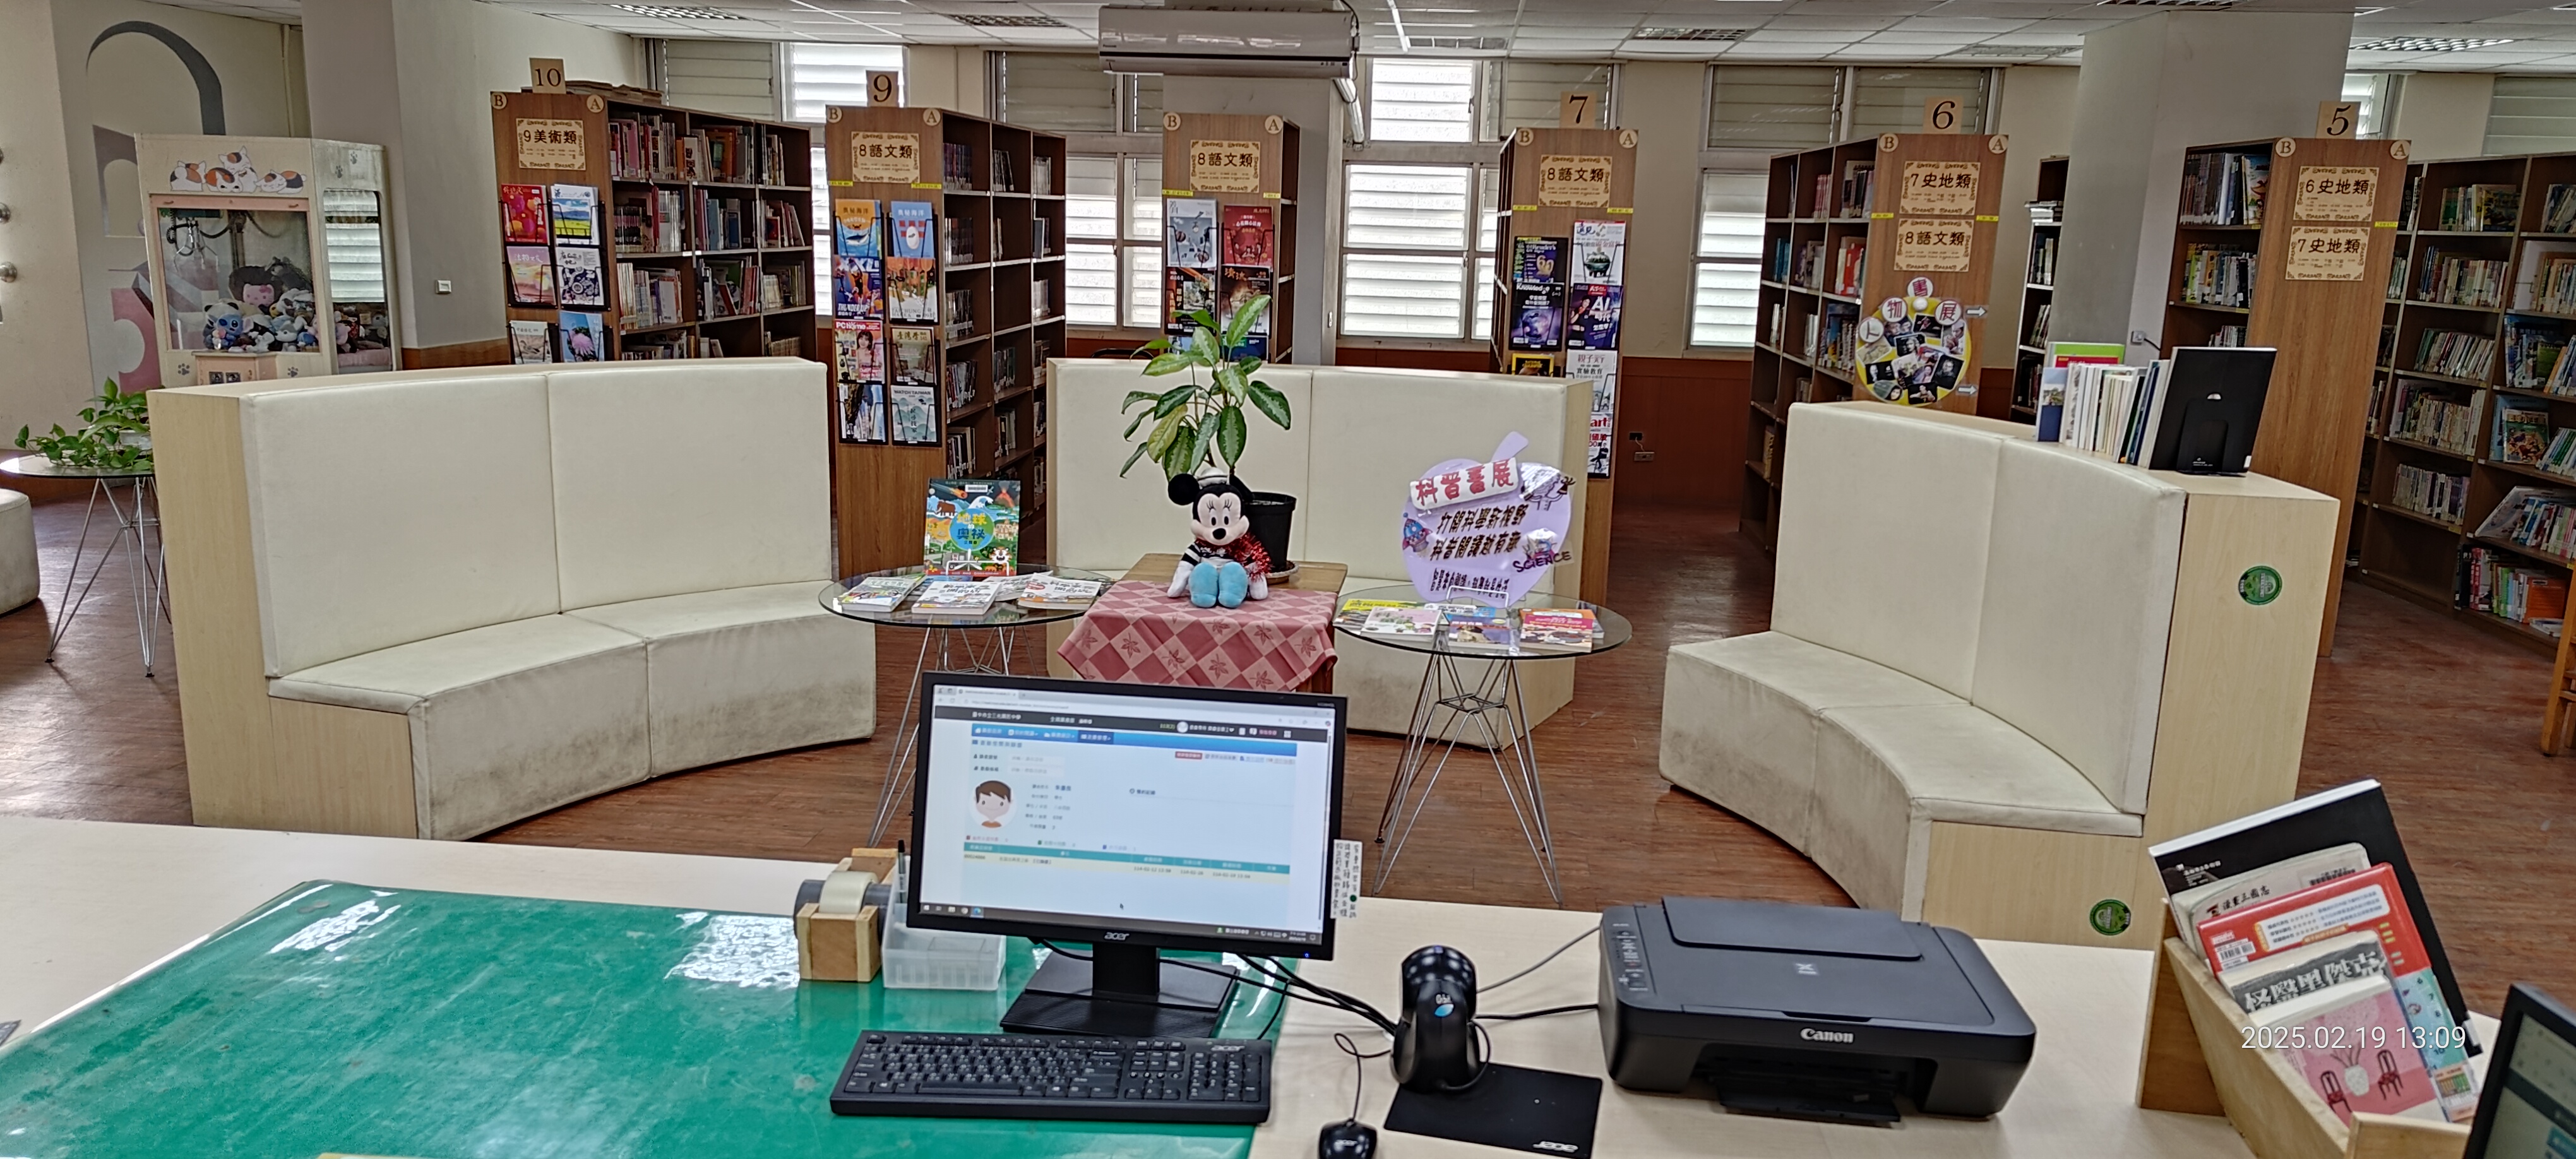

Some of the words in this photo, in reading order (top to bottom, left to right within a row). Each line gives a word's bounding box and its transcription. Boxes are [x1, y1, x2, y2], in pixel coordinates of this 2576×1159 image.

[535, 68, 561, 86] 10
[873, 74, 892, 102] 9
[494, 95, 503, 106] B
[590, 98, 601, 110] A
[829, 108, 838, 120] B
[1569, 95, 1589, 124] 7
[1932, 101, 1955, 129] 6
[926, 111, 938, 123] A
[1167, 116, 1177, 128] B
[2327, 104, 2351, 136] 5
[1268, 119, 1279, 131] A
[1520, 131, 1530, 143] B
[1622, 133, 1634, 145] A
[1883, 136, 1894, 148] B
[859, 144, 912, 158] 8語文類
[1992, 138, 2004, 151] A
[2280, 141, 2292, 154] B
[2393, 144, 2407, 157] A
[1198, 153, 1253, 167] 8語文類
[1547, 167, 1604, 183] 8語文類
[2306, 178, 2369, 195] 6史地類
[1905, 231, 1965, 246] 8語文類
[2298, 238, 2361, 254] 7史地類
[957, 513, 987, 525] 地球
[1104, 931, 1130, 941] acer
[1800, 1028, 1854, 1043] Canon
